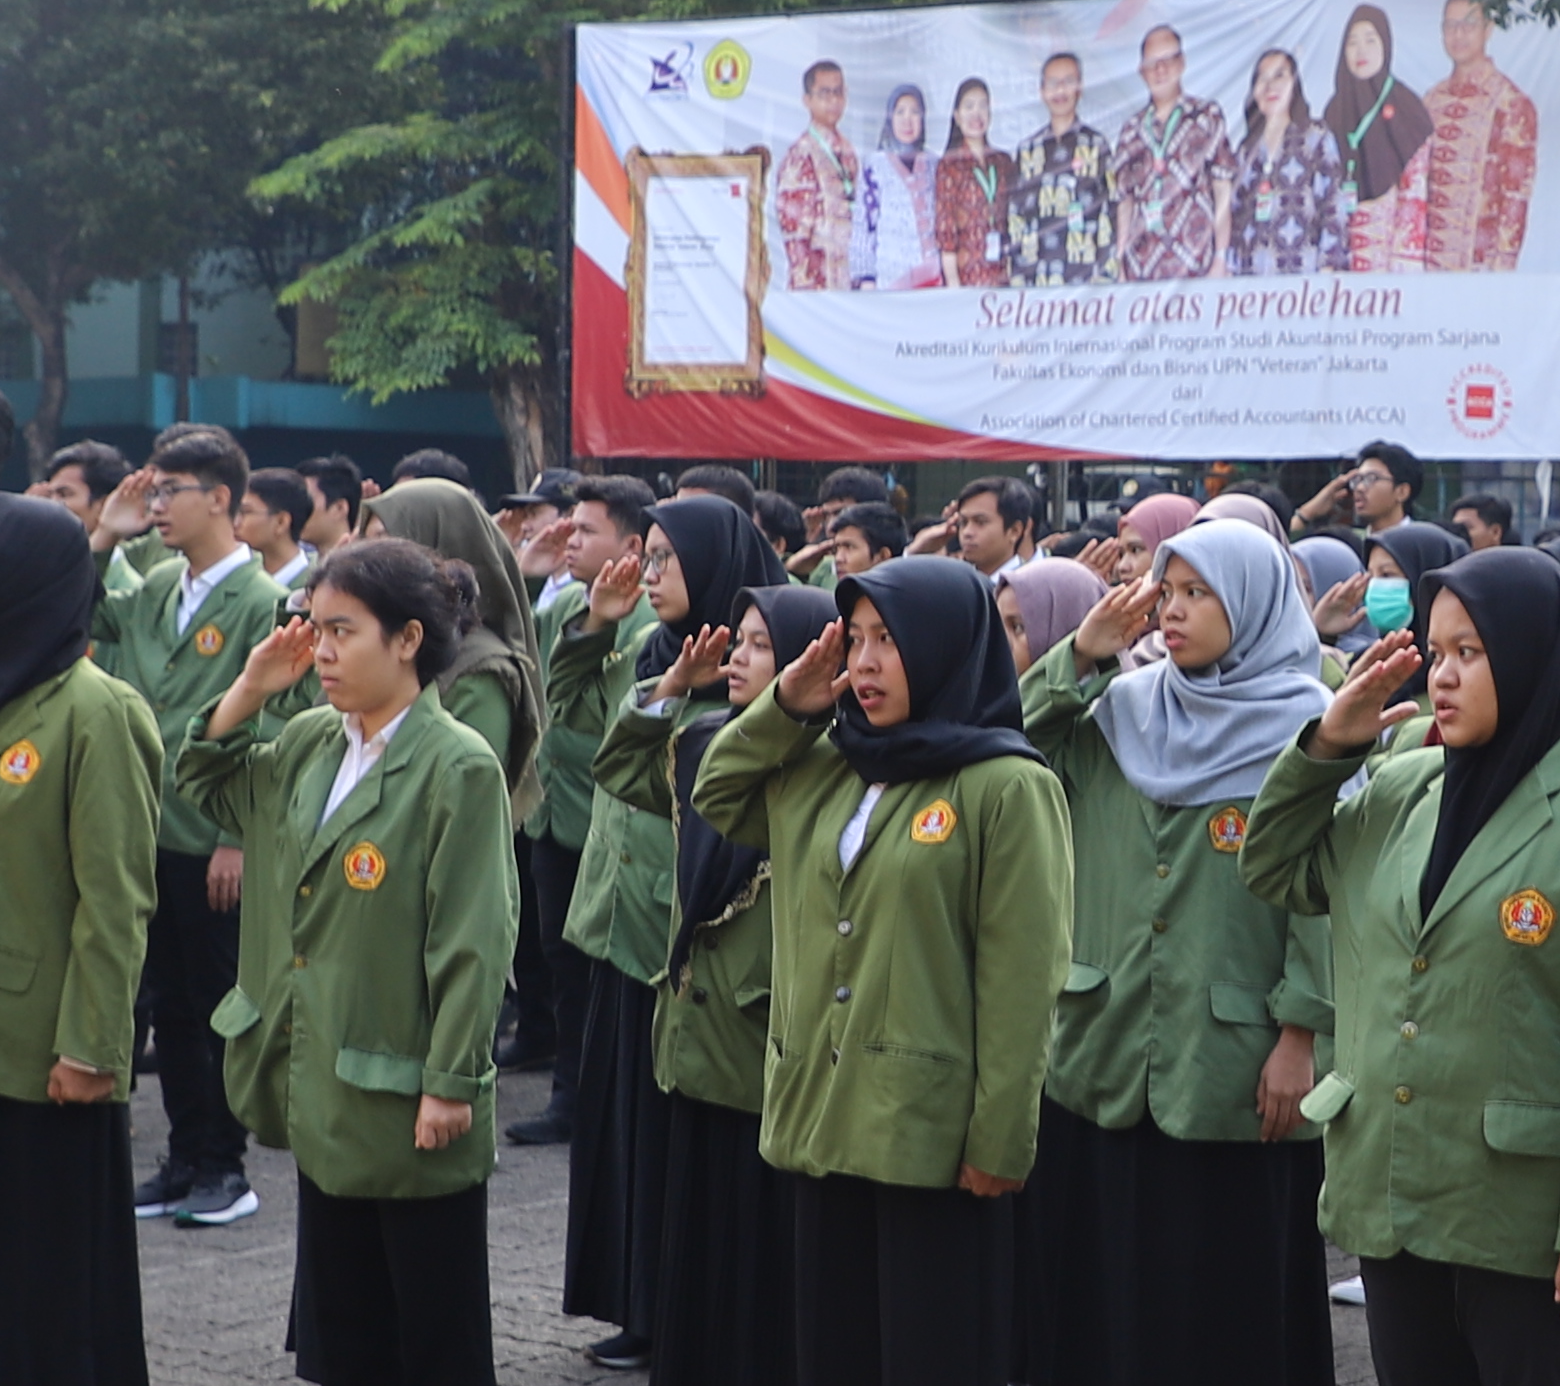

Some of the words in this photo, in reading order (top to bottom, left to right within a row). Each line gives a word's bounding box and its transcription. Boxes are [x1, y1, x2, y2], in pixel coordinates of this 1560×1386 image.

[975, 290, 1116, 330] Selamat
[1128, 290, 1203, 324] atas
[1215, 278, 1402, 329] perolehan
[895, 341, 969, 358] Akreditasi
[973, 339, 1049, 357] Kurikulum
[1053, 337, 1154, 355] Internasional
[1159, 335, 1225, 353] Program
[1230, 332, 1272, 349] Studi
[1277, 331, 1357, 348] Akuntansi
[1362, 330, 1433, 351] Program
[1437, 329, 1501, 349] Sarjana
[992, 363, 1055, 381] Fakultas
[1059, 362, 1127, 380] Ekonomi
[1131, 360, 1160, 378] dan
[1164, 359, 1209, 376] Bisnis
[1212, 357, 1248, 374] UPN
[1327, 355, 1389, 373] Jakarta
[1172, 385, 1203, 401] dari
[980, 413, 1066, 430] Association
[1070, 412, 1087, 428] of
[1090, 411, 1167, 428] Chartered
[1170, 409, 1238, 427] Certified
[1243, 408, 1343, 426] Accountants
[1345, 407, 1407, 426] (ACCA)
